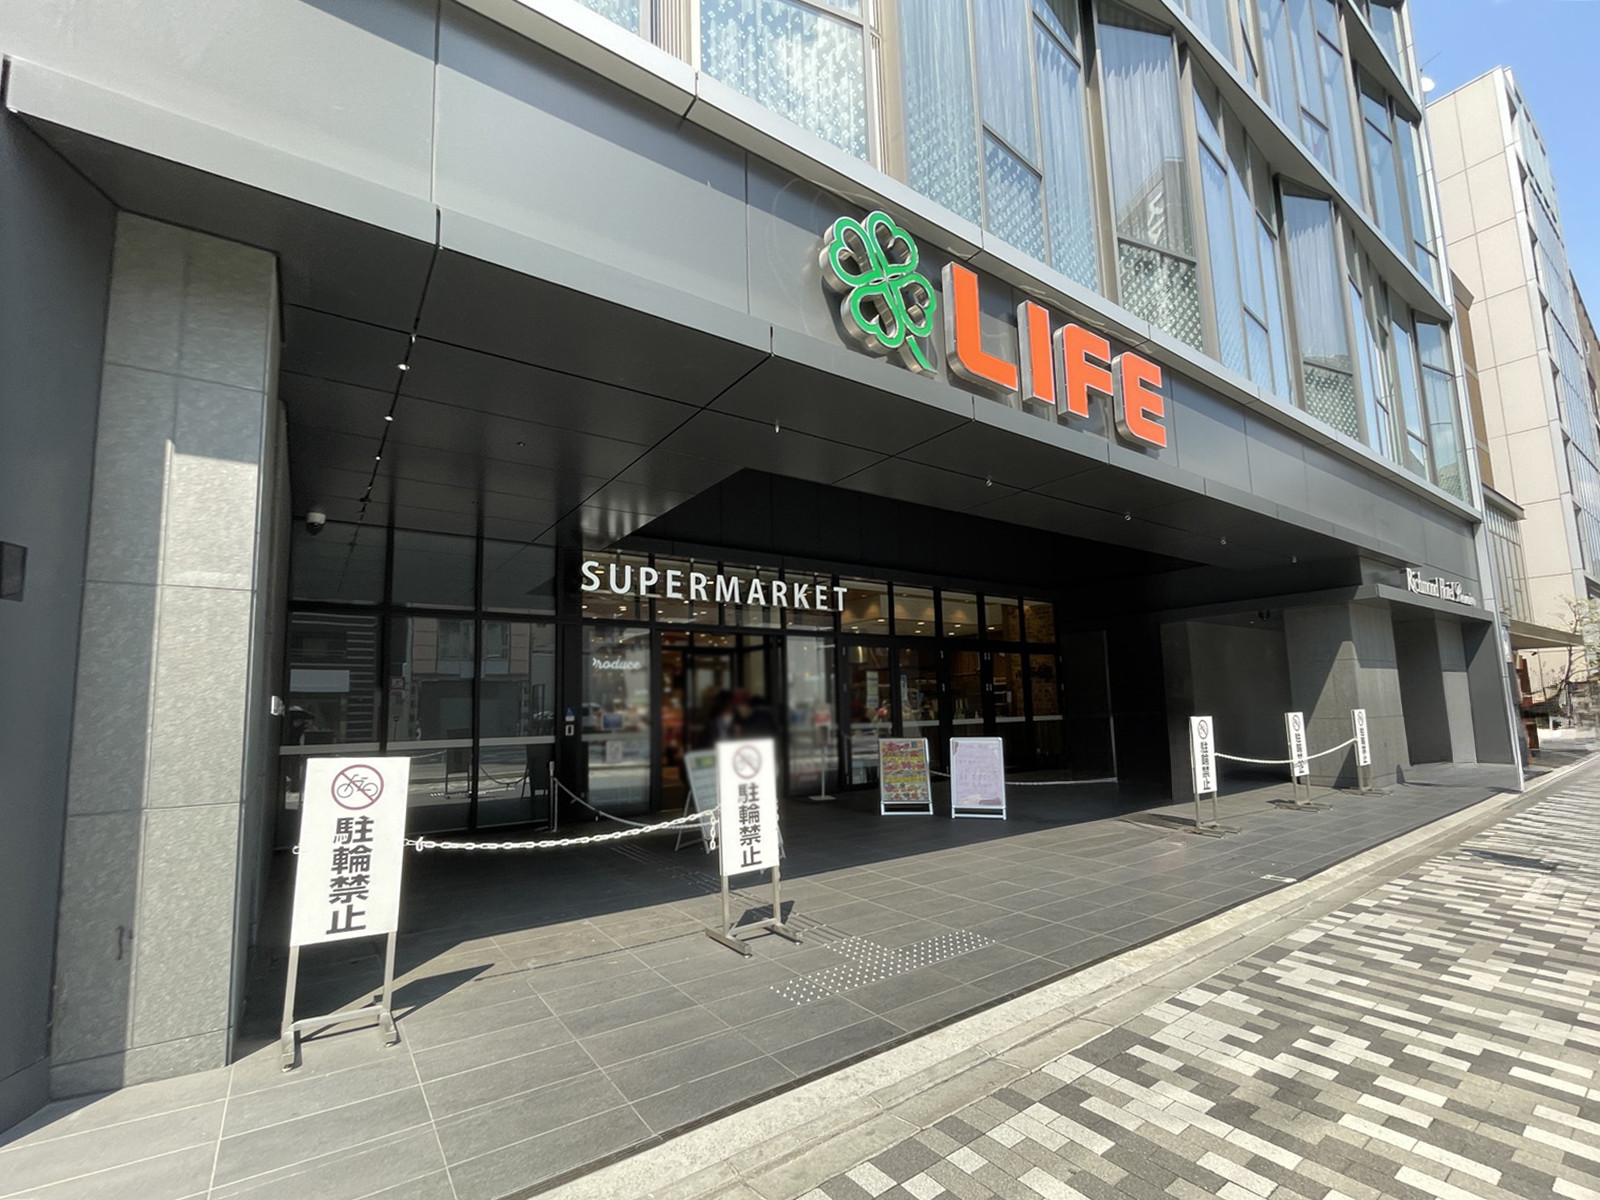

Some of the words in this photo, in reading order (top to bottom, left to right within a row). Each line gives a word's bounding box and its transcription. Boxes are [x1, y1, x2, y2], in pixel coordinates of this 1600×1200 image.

[941, 261, 1167, 448] LIFE
[580, 560, 848, 612] SUPERMARKET
[325, 815, 375, 935] 駐輪禁止
[738, 782, 762, 868] 駐輪禁止
